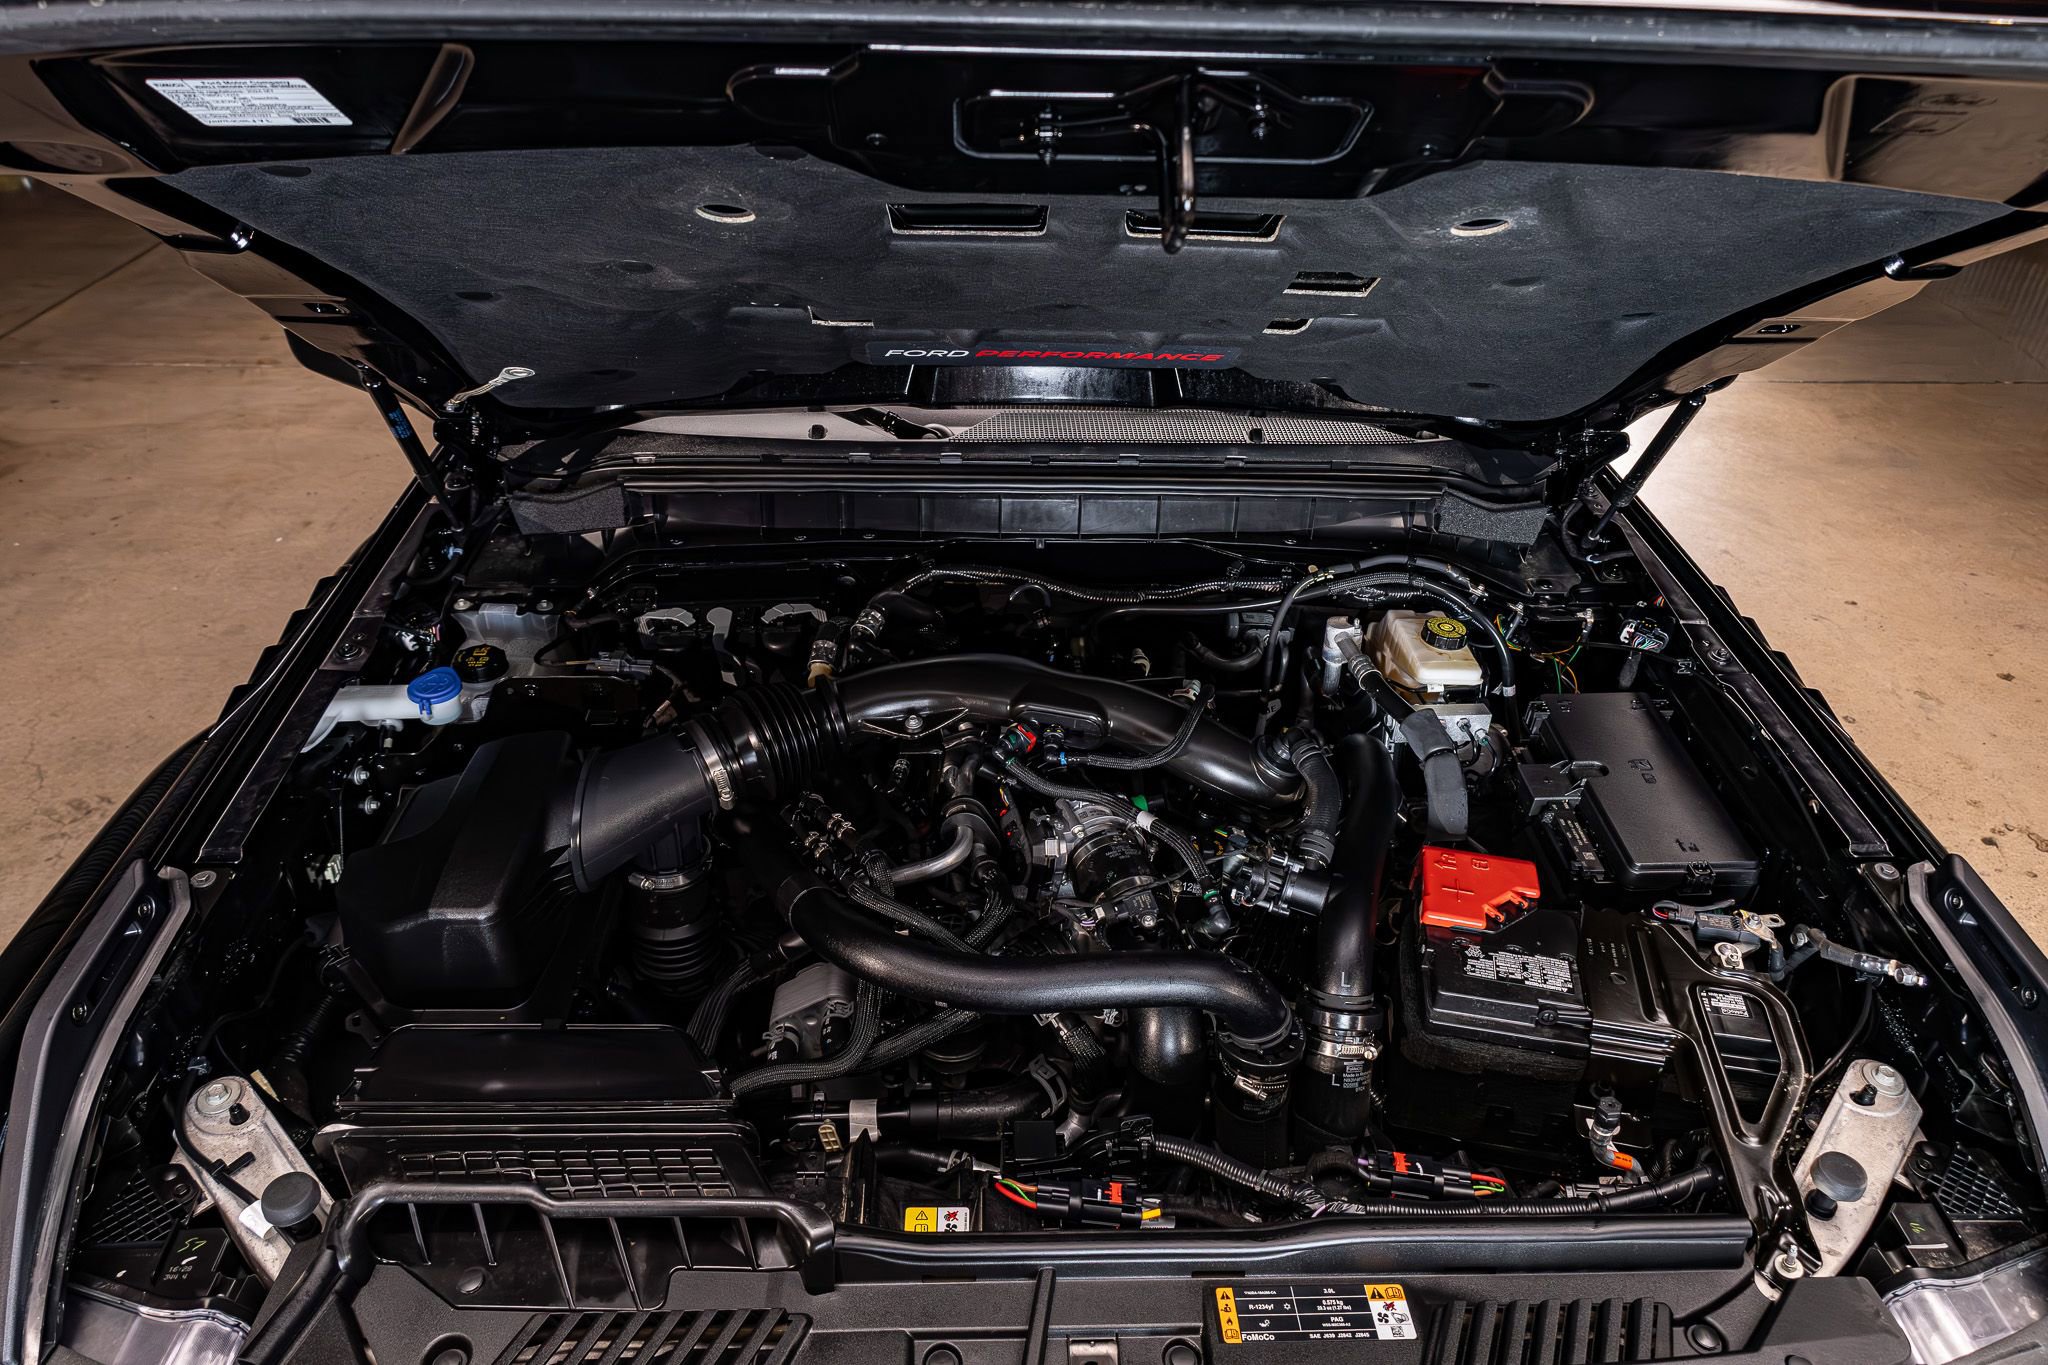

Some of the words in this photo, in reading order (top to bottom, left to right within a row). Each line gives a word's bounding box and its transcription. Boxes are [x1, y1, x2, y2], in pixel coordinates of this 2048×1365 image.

[884, 350, 970, 358] FORD
[975, 350, 1224, 361] PERFORMANCE
[1341, 972, 1351, 987] L
[1331, 1073, 1341, 1087] L
[1248, 1303, 1274, 1311] R-1234yf
[1241, 1333, 1276, 1341] FoMoCo
